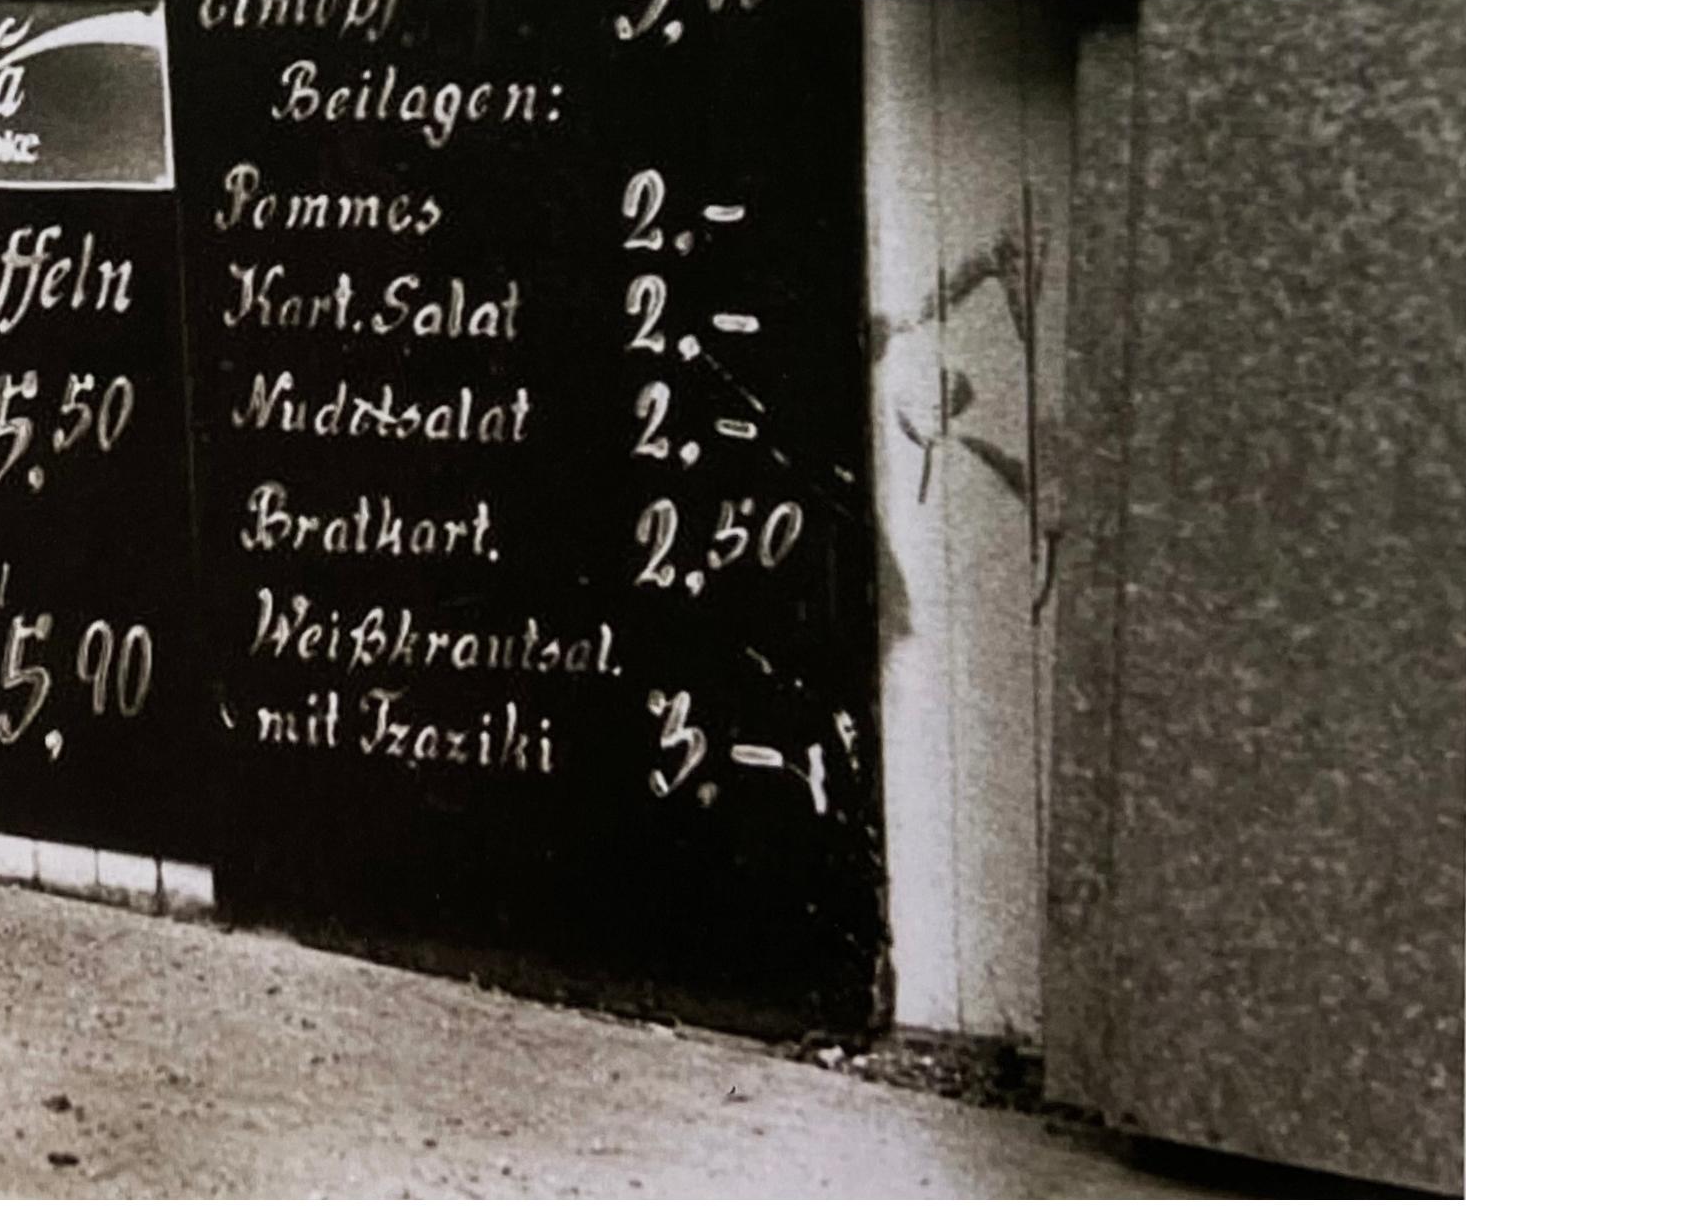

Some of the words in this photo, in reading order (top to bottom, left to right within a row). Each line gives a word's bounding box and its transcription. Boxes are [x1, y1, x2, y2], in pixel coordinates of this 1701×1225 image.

[271, 60, 563, 148] Beilagen:
[215, 162, 442, 233] Pommes
[239, 480, 500, 562] Bratkart.
[635, 498, 804, 597] 2,50
[249, 588, 622, 676] Weißkrautsal.
[258, 691, 339, 749] mit
[359, 687, 555, 774] Tzaziki
